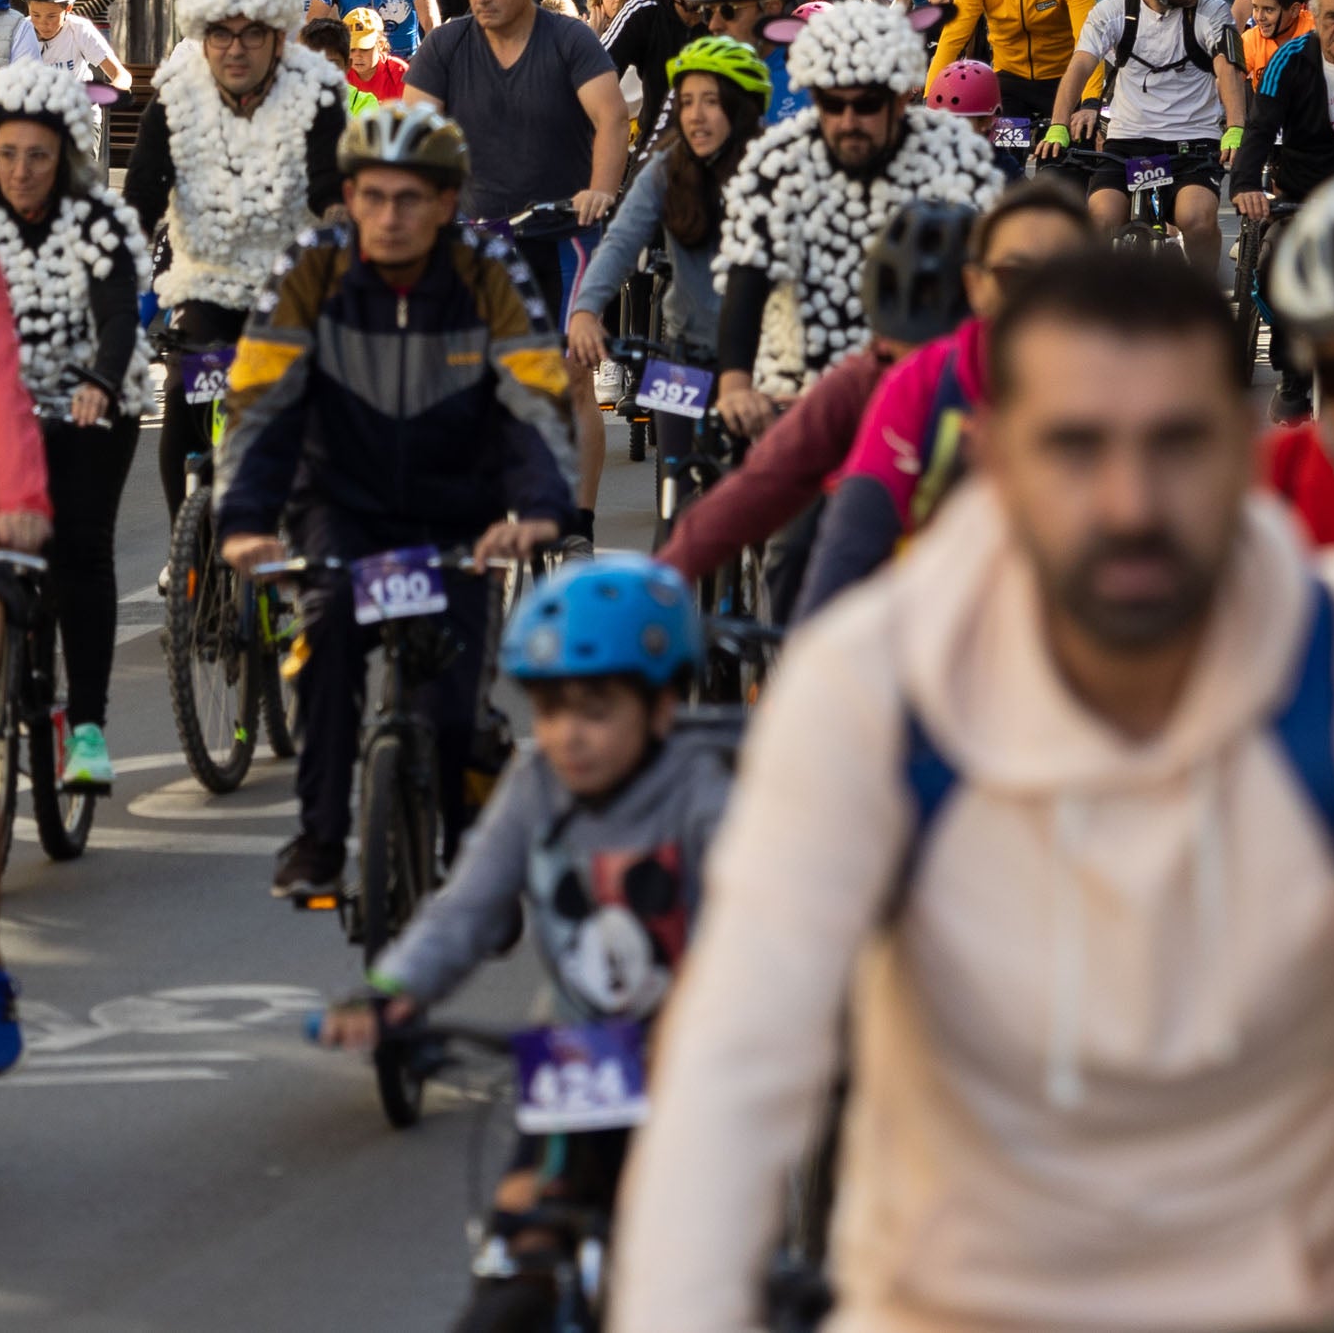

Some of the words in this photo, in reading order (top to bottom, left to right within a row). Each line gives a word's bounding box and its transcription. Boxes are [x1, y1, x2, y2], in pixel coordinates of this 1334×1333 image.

[1133, 166, 1166, 184] 300
[649, 379, 700, 407] 397
[369, 572, 430, 606] 190
